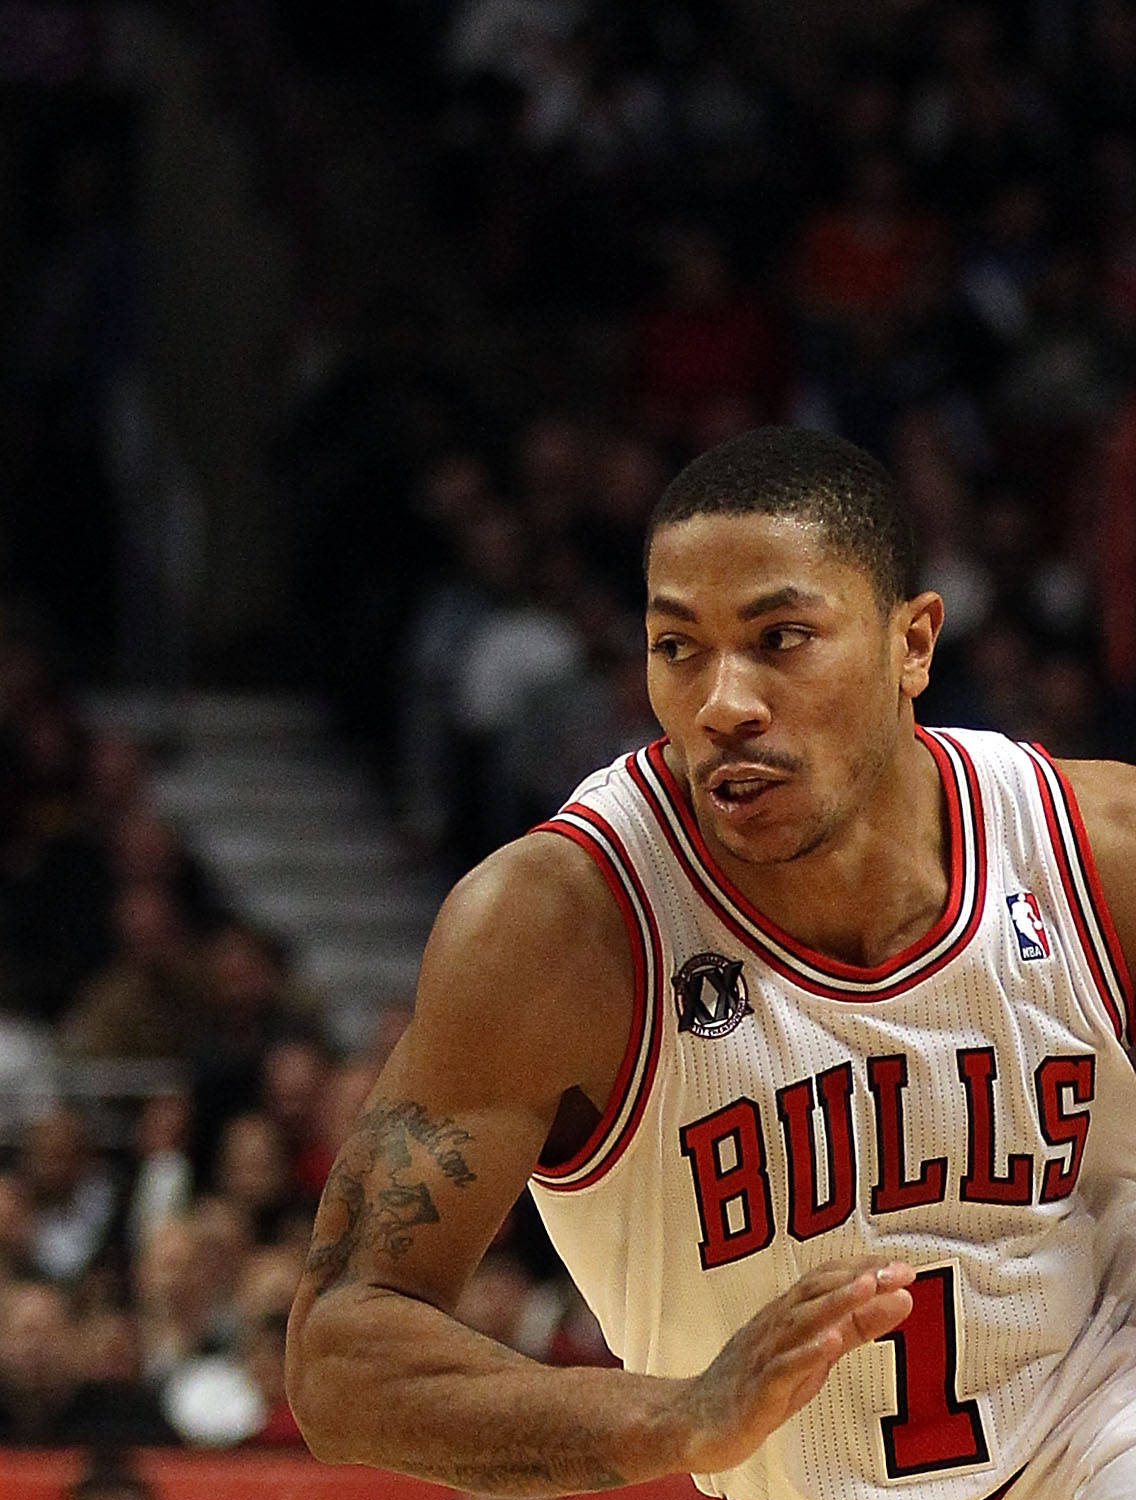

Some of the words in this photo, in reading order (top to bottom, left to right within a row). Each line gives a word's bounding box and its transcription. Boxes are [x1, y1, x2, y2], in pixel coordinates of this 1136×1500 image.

[1022, 945, 1042, 959] NBA
[679, 1046, 1096, 1271] BULLS
[874, 1265, 991, 1480] 1
